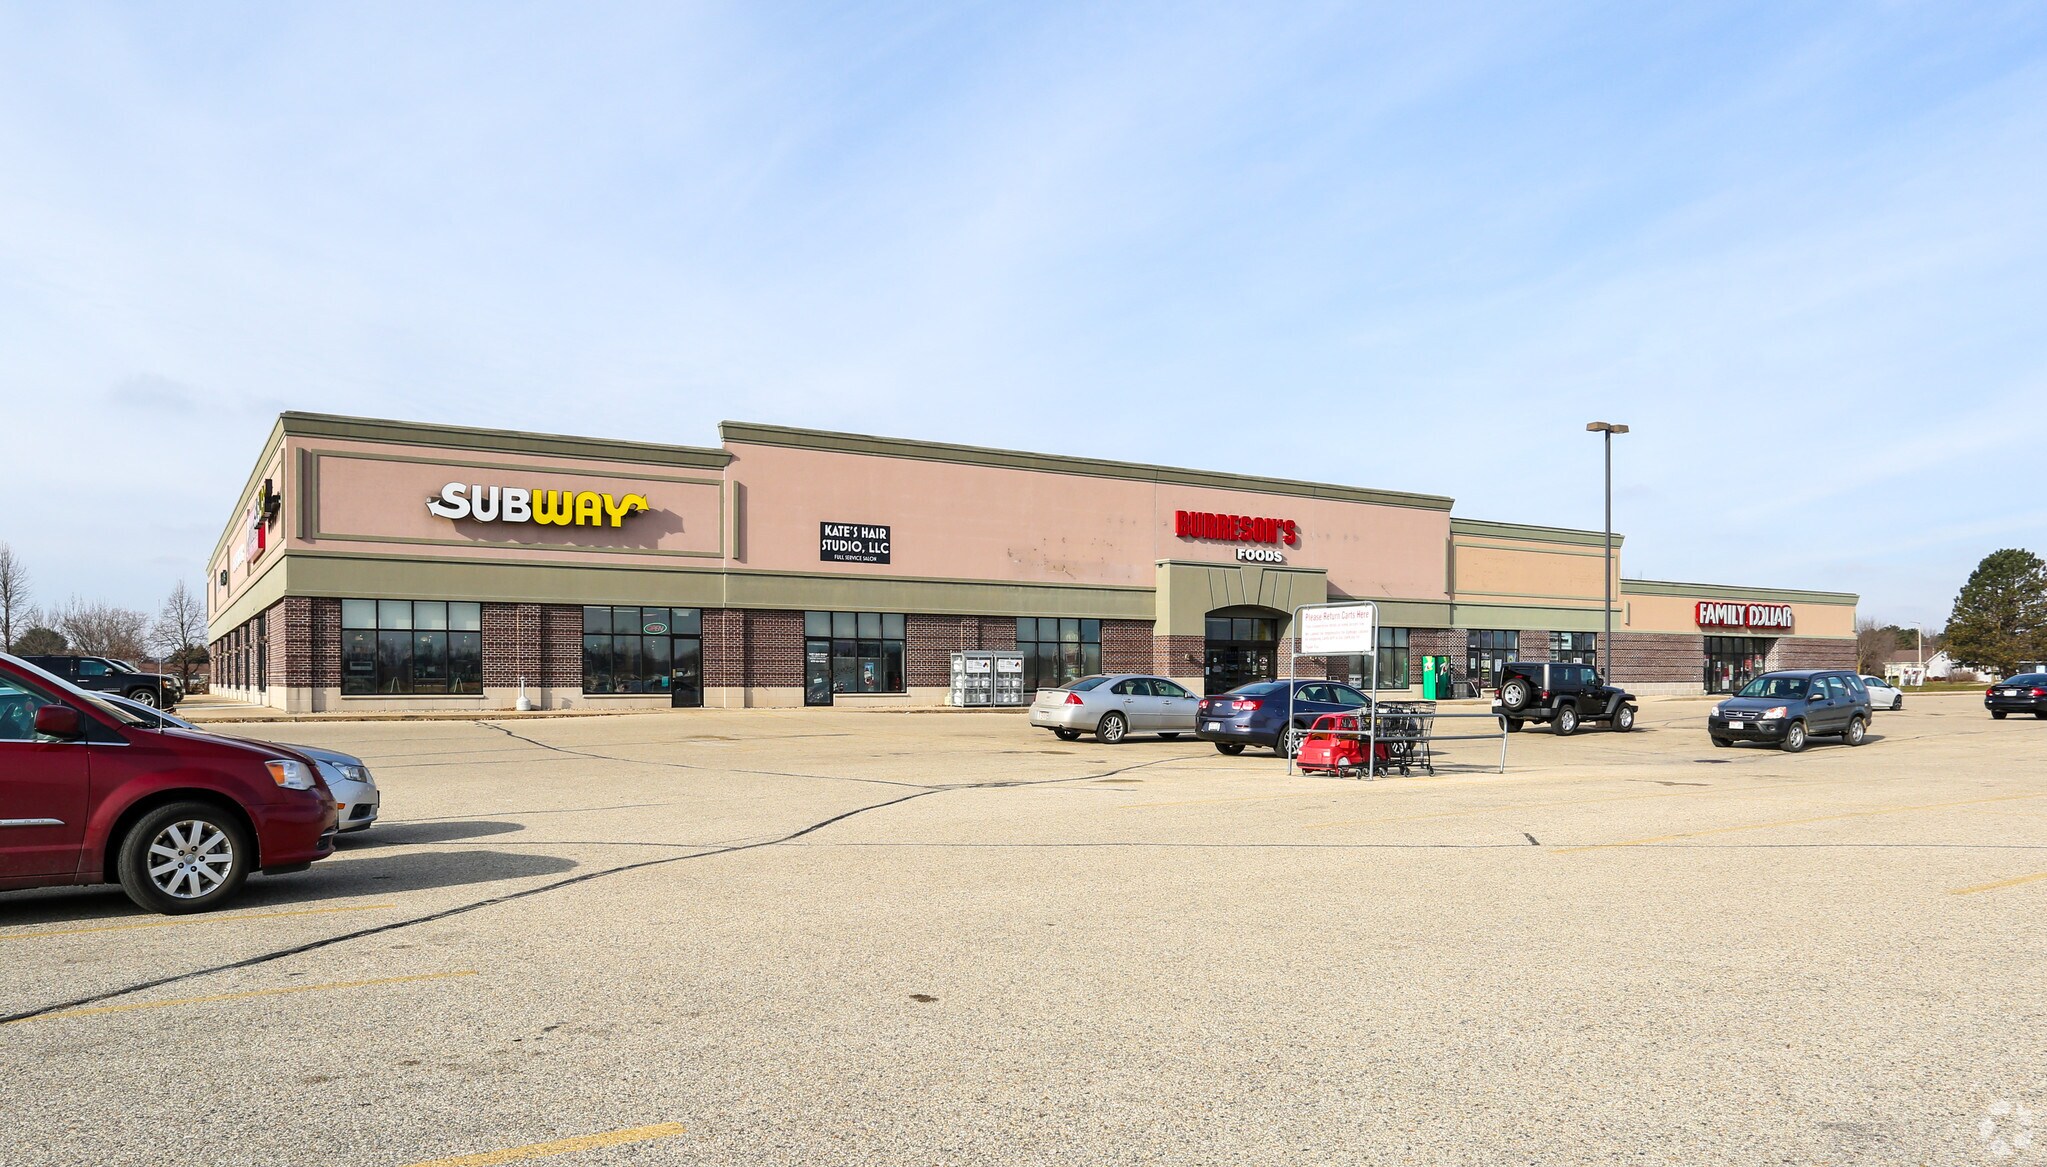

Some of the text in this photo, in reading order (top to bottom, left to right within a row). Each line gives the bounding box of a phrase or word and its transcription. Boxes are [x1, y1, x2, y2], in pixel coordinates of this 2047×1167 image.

[426, 482, 650, 528] SUBWAY
[825, 524, 887, 540] KATE'S HAIR
[1175, 510, 1297, 545] BURRESON'S
[821, 539, 889, 554] STUDIO, LLC
[1236, 548, 1282, 562] FOODS
[1305, 610, 1369, 621] Please Return Carts Here
[1697, 602, 1793, 627] FAMILY DOLLAR
